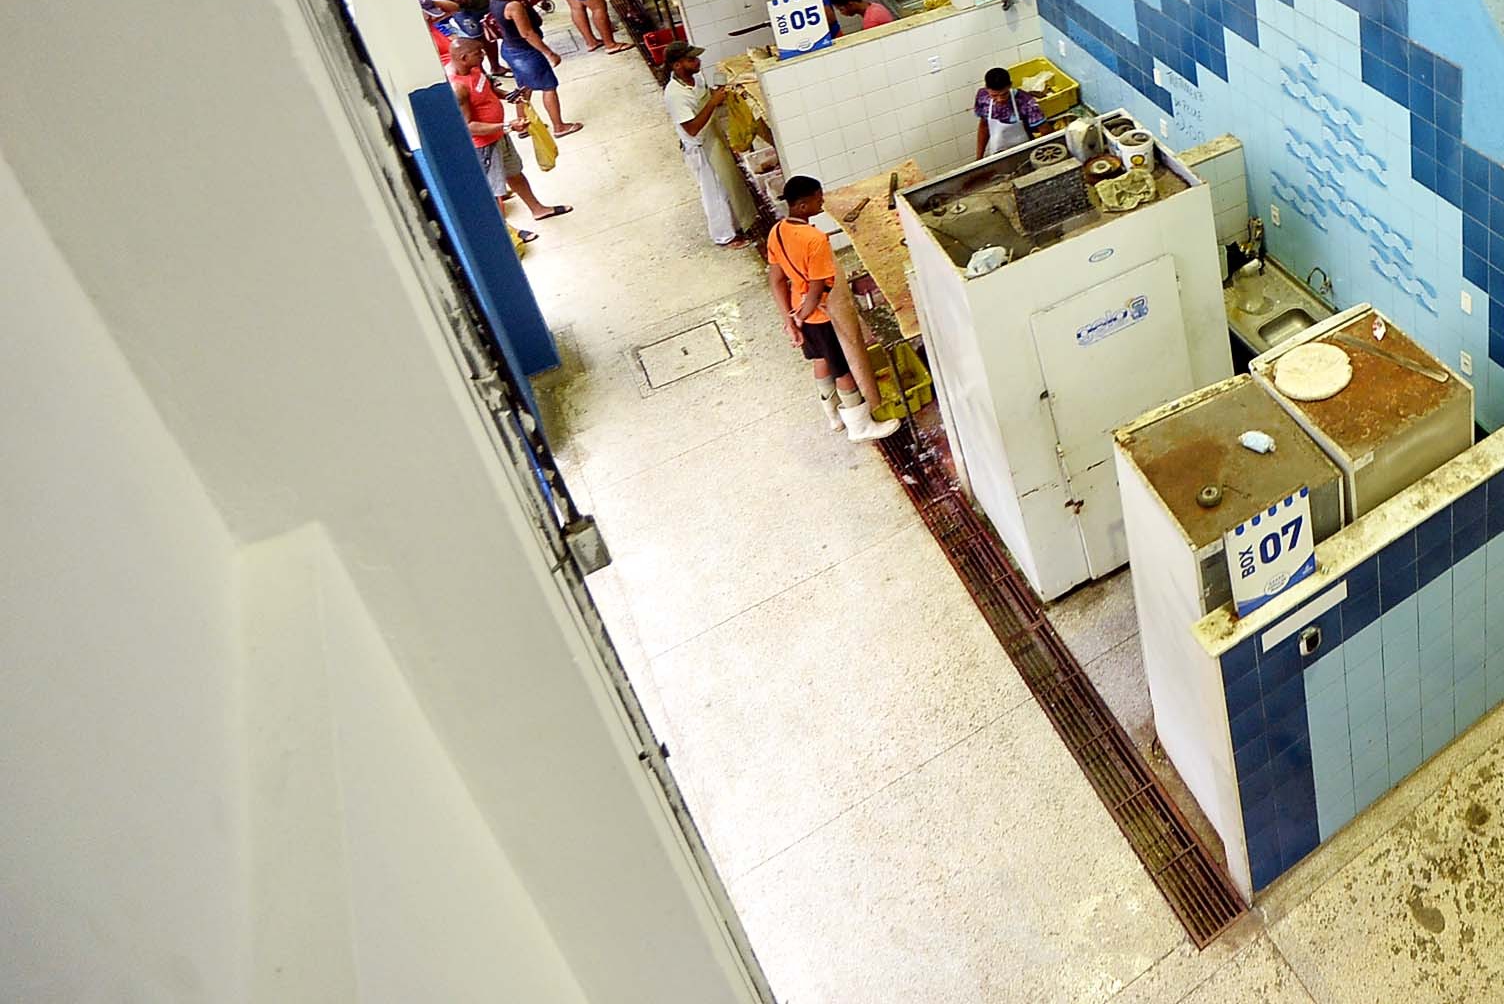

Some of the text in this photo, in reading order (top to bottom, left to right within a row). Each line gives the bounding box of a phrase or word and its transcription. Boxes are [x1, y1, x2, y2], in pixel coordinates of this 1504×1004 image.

[775, 5, 821, 35] BOX 05
[1238, 515, 1303, 580] BOX 07
